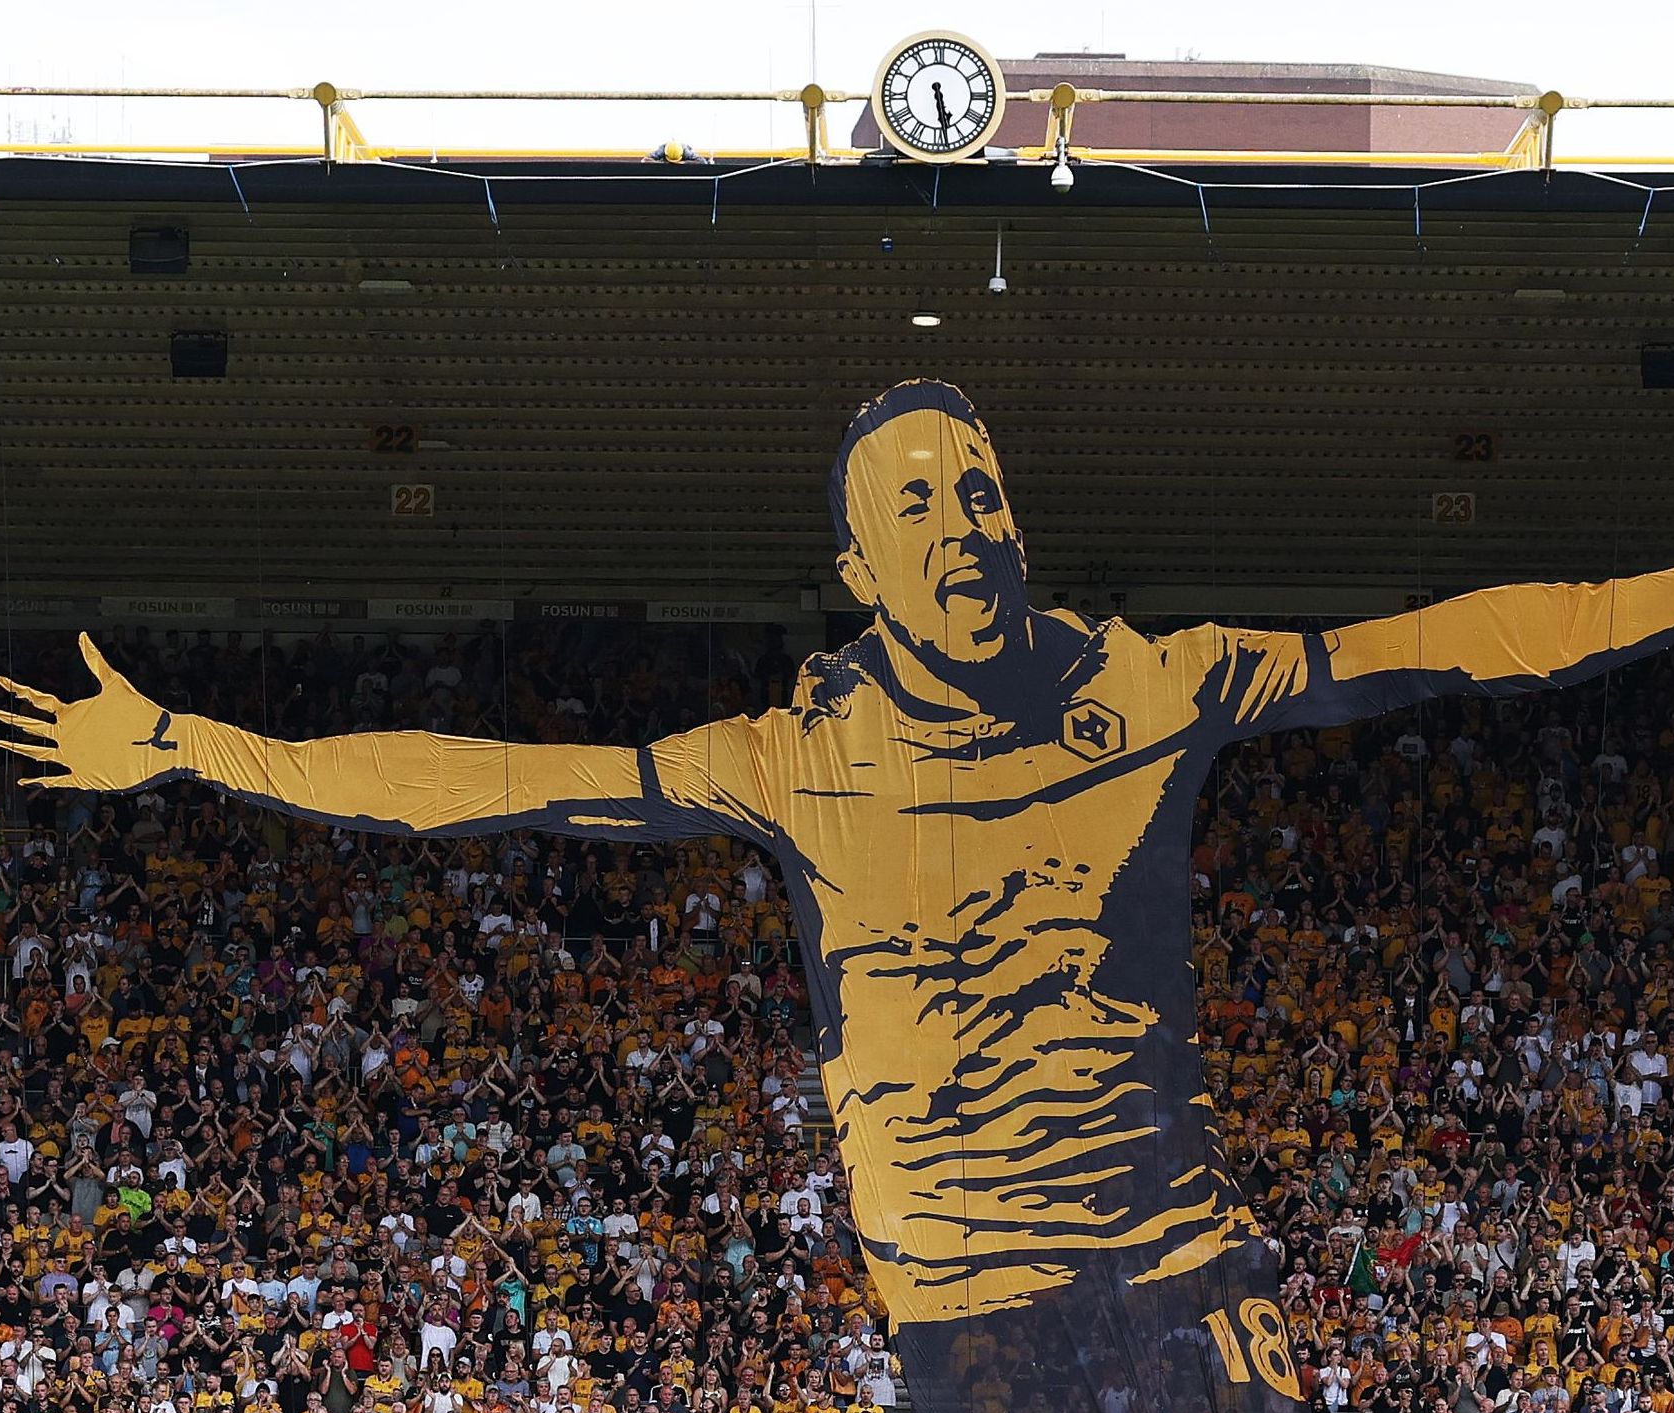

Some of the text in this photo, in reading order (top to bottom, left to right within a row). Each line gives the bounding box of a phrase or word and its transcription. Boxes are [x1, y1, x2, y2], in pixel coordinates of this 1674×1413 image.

[375, 426, 413, 450] 22
[1455, 434, 1493, 460] 23
[395, 487, 430, 513] 22
[1437, 495, 1471, 521] 23
[129, 601, 178, 613] FOSUN
[262, 602, 311, 615] FOSUN
[395, 604, 445, 616] FOSUN
[541, 605, 591, 617] FOSUN
[662, 606, 711, 618] FOSUN
[1201, 1297, 1307, 1402] 18
